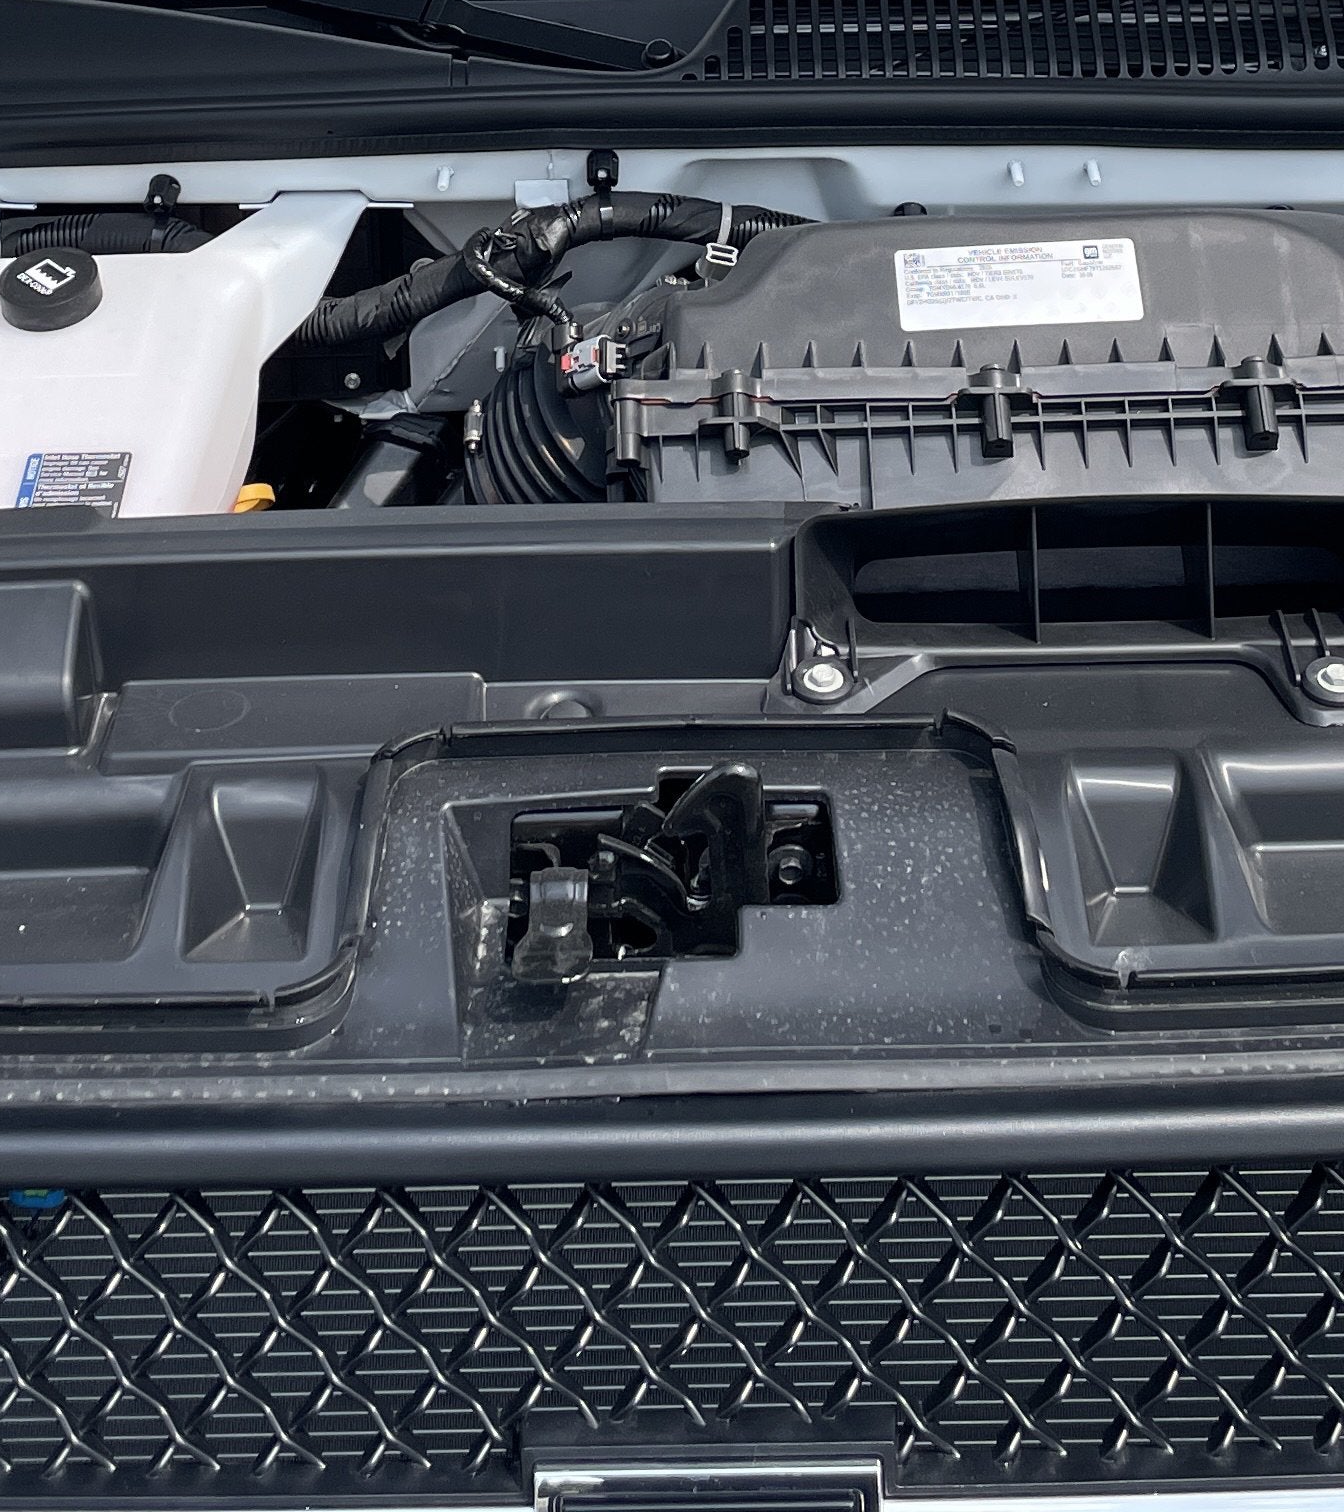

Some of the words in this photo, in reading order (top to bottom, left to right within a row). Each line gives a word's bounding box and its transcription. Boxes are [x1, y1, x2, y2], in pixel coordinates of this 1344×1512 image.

[968, 248, 1002, 256] VEHICLE
[1004, 246, 1043, 255] EMISSION
[957, 255, 997, 264] CONTROL
[998, 253, 1054, 262] INFORMATION
